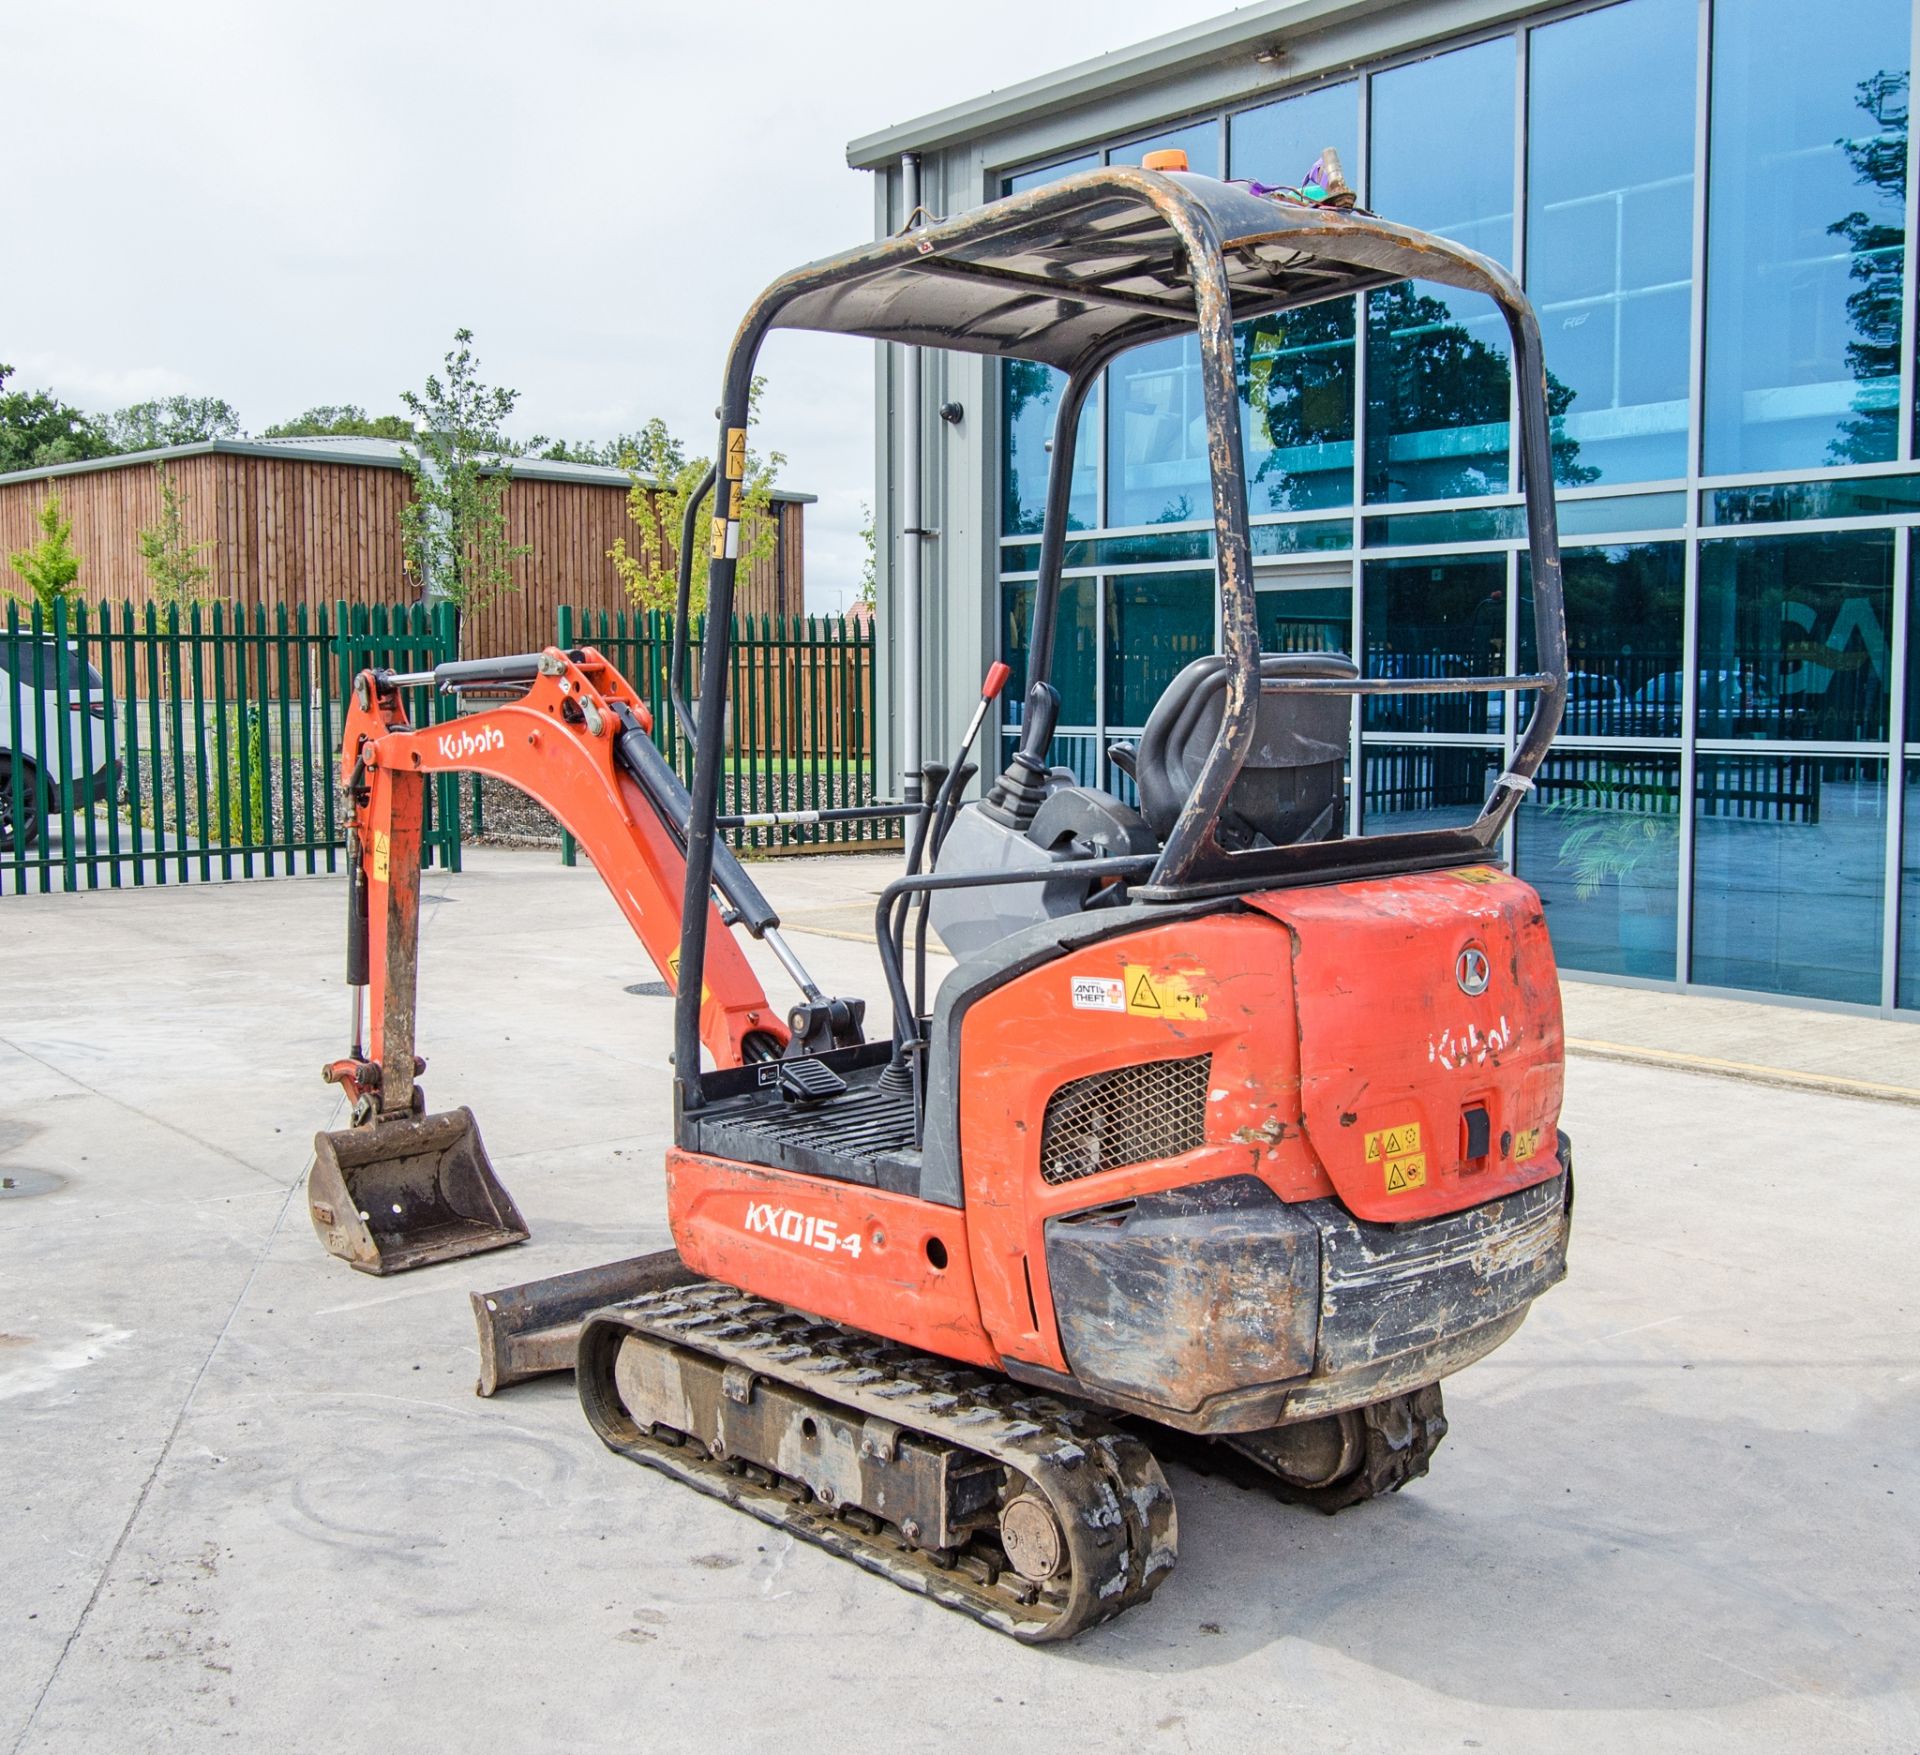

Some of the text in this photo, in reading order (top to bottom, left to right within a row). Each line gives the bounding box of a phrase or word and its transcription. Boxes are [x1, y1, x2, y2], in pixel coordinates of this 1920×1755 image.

[438, 726, 505, 760] Kubota
[1074, 984, 1099, 993] ANTI
[1074, 993, 1105, 1002] THEFT
[1428, 1015, 1518, 1070] Kubot
